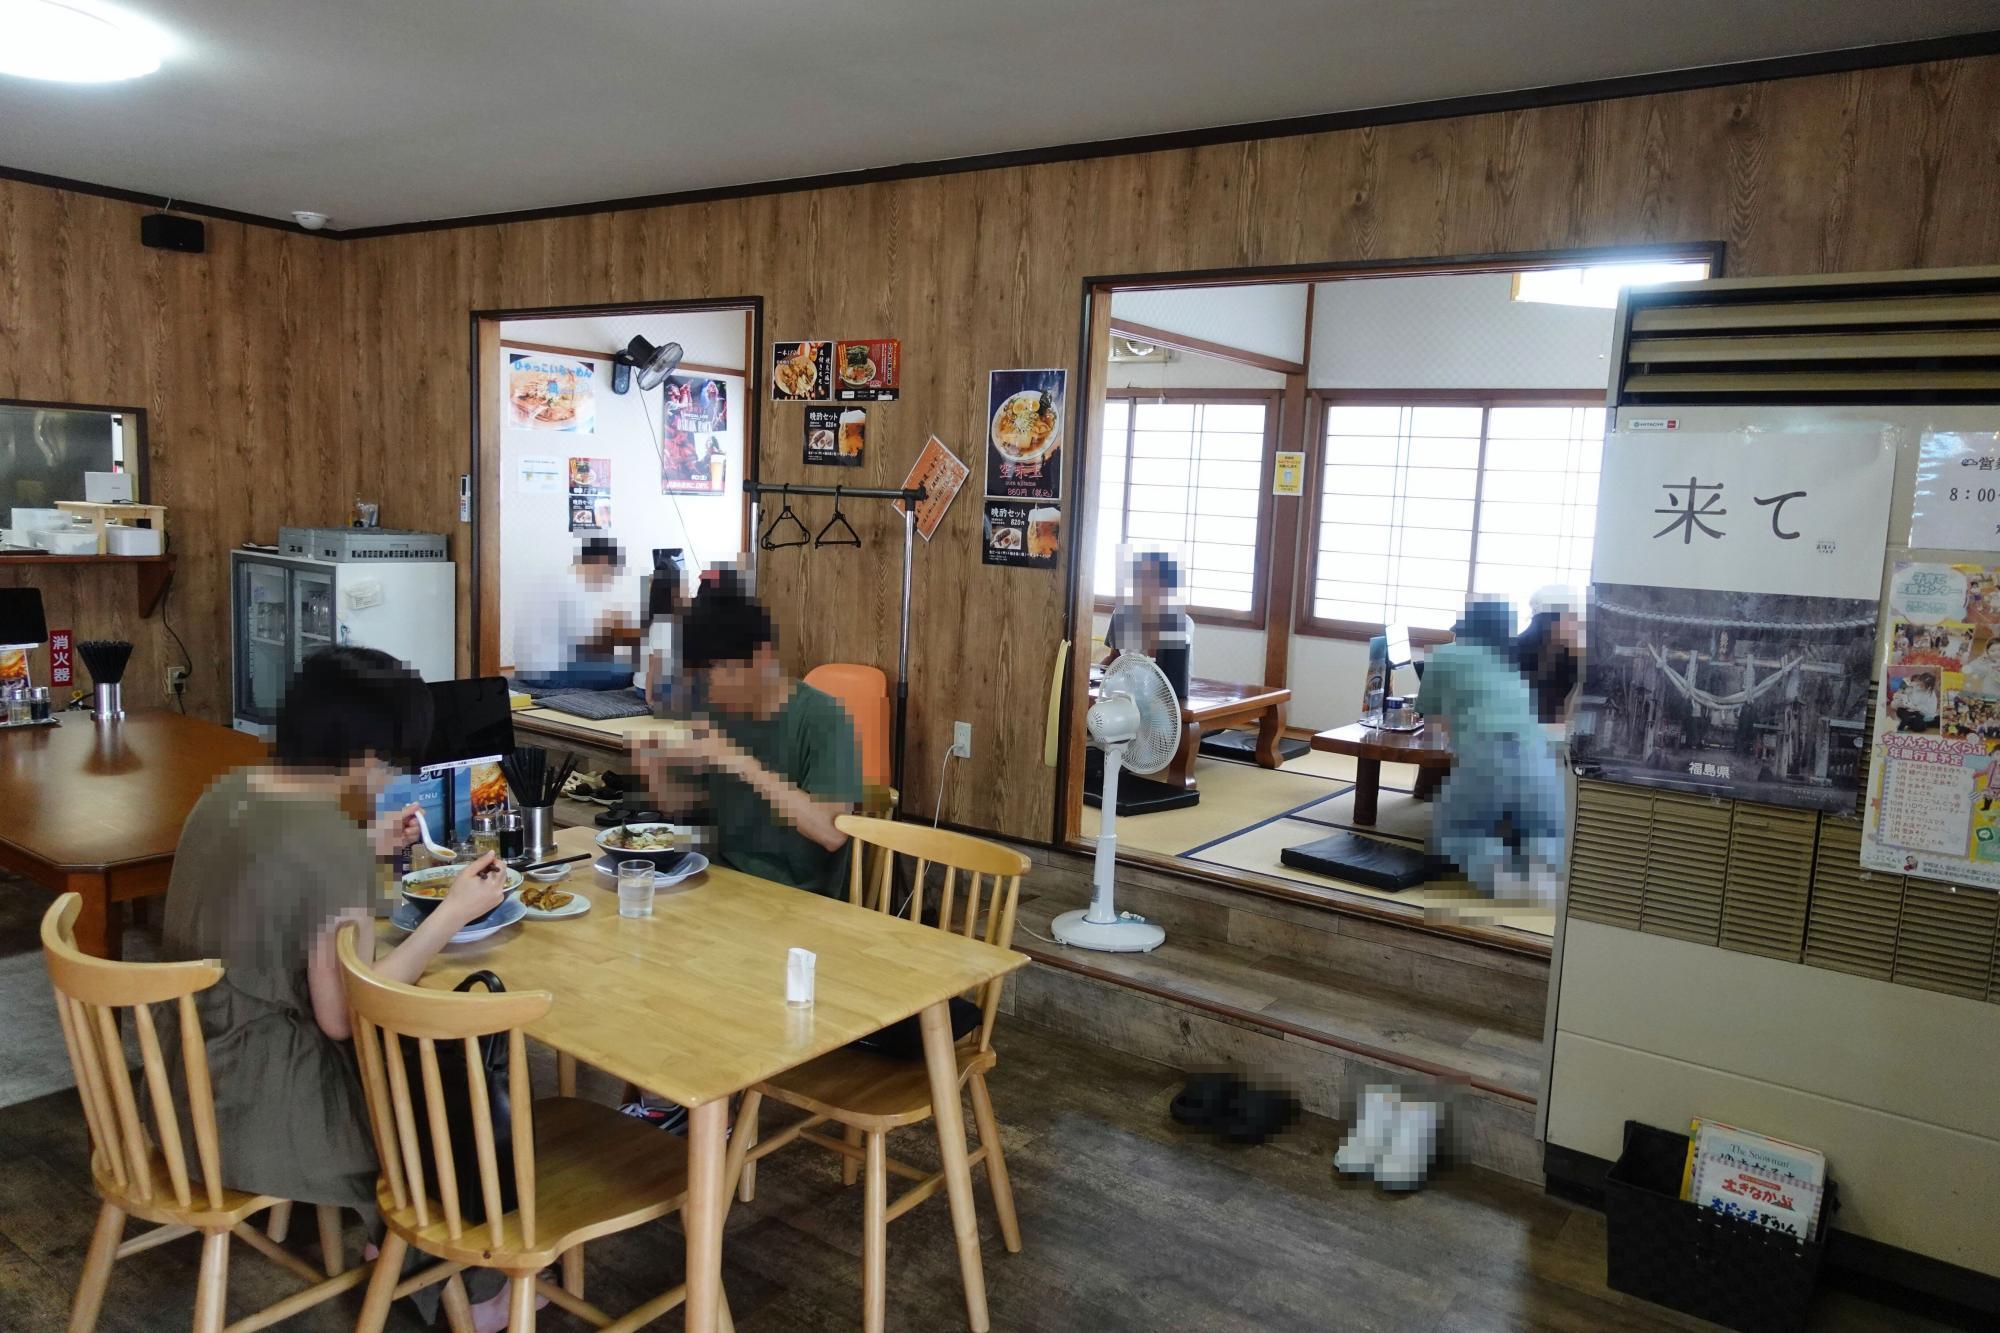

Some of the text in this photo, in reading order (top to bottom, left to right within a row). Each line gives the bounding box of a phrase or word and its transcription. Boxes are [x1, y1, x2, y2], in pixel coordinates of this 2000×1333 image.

[991, 508, 1026, 518] 晩酌セット
[1653, 476, 1807, 544] 来て
[52, 635, 70, 682] 消火器
[1888, 746, 1964, 767] 年間行事予定
[1688, 762, 1730, 779] 福島県
[1730, 1144, 1746, 1155] The
[1749, 1150, 1791, 1168] Snowman
